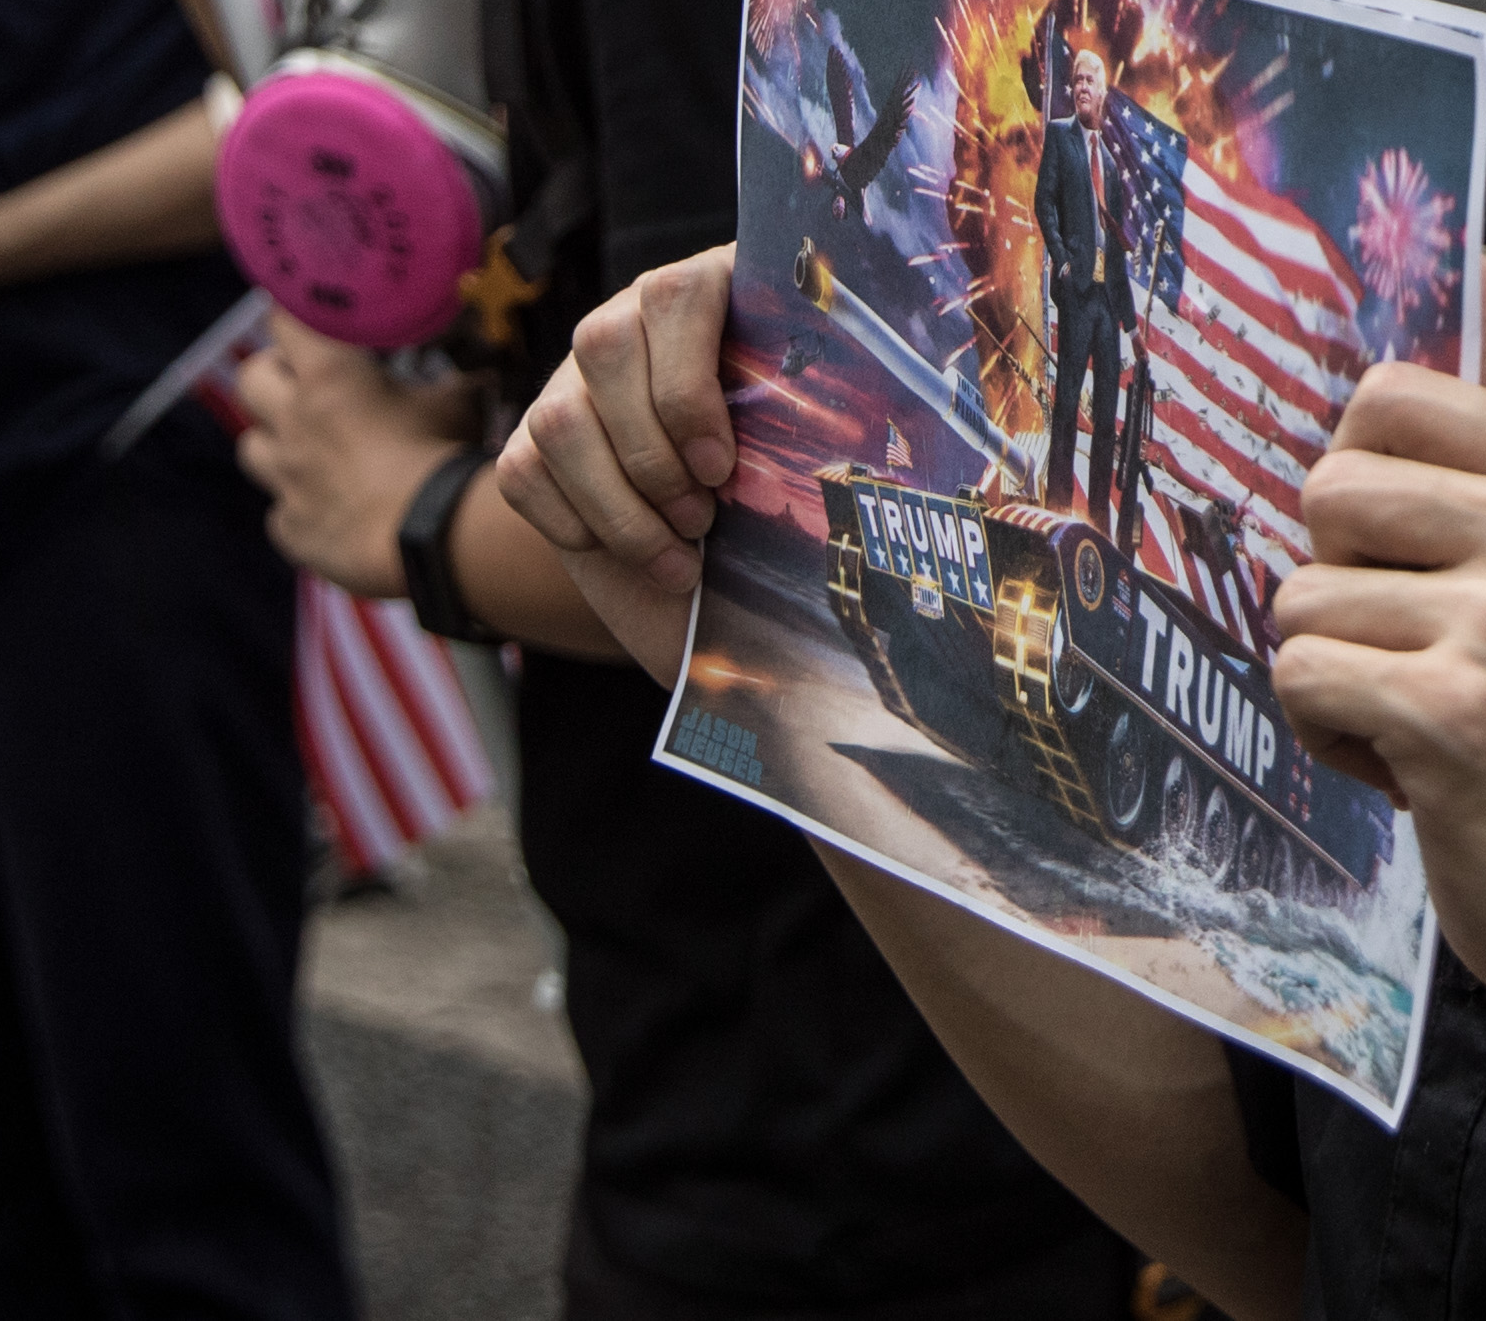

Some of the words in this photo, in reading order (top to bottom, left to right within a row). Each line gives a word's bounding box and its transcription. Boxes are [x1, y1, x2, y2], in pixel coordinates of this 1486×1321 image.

[858, 493, 985, 568] TRUMP
[1138, 588, 1276, 787] TRUMP
[680, 706, 758, 757] JASON
